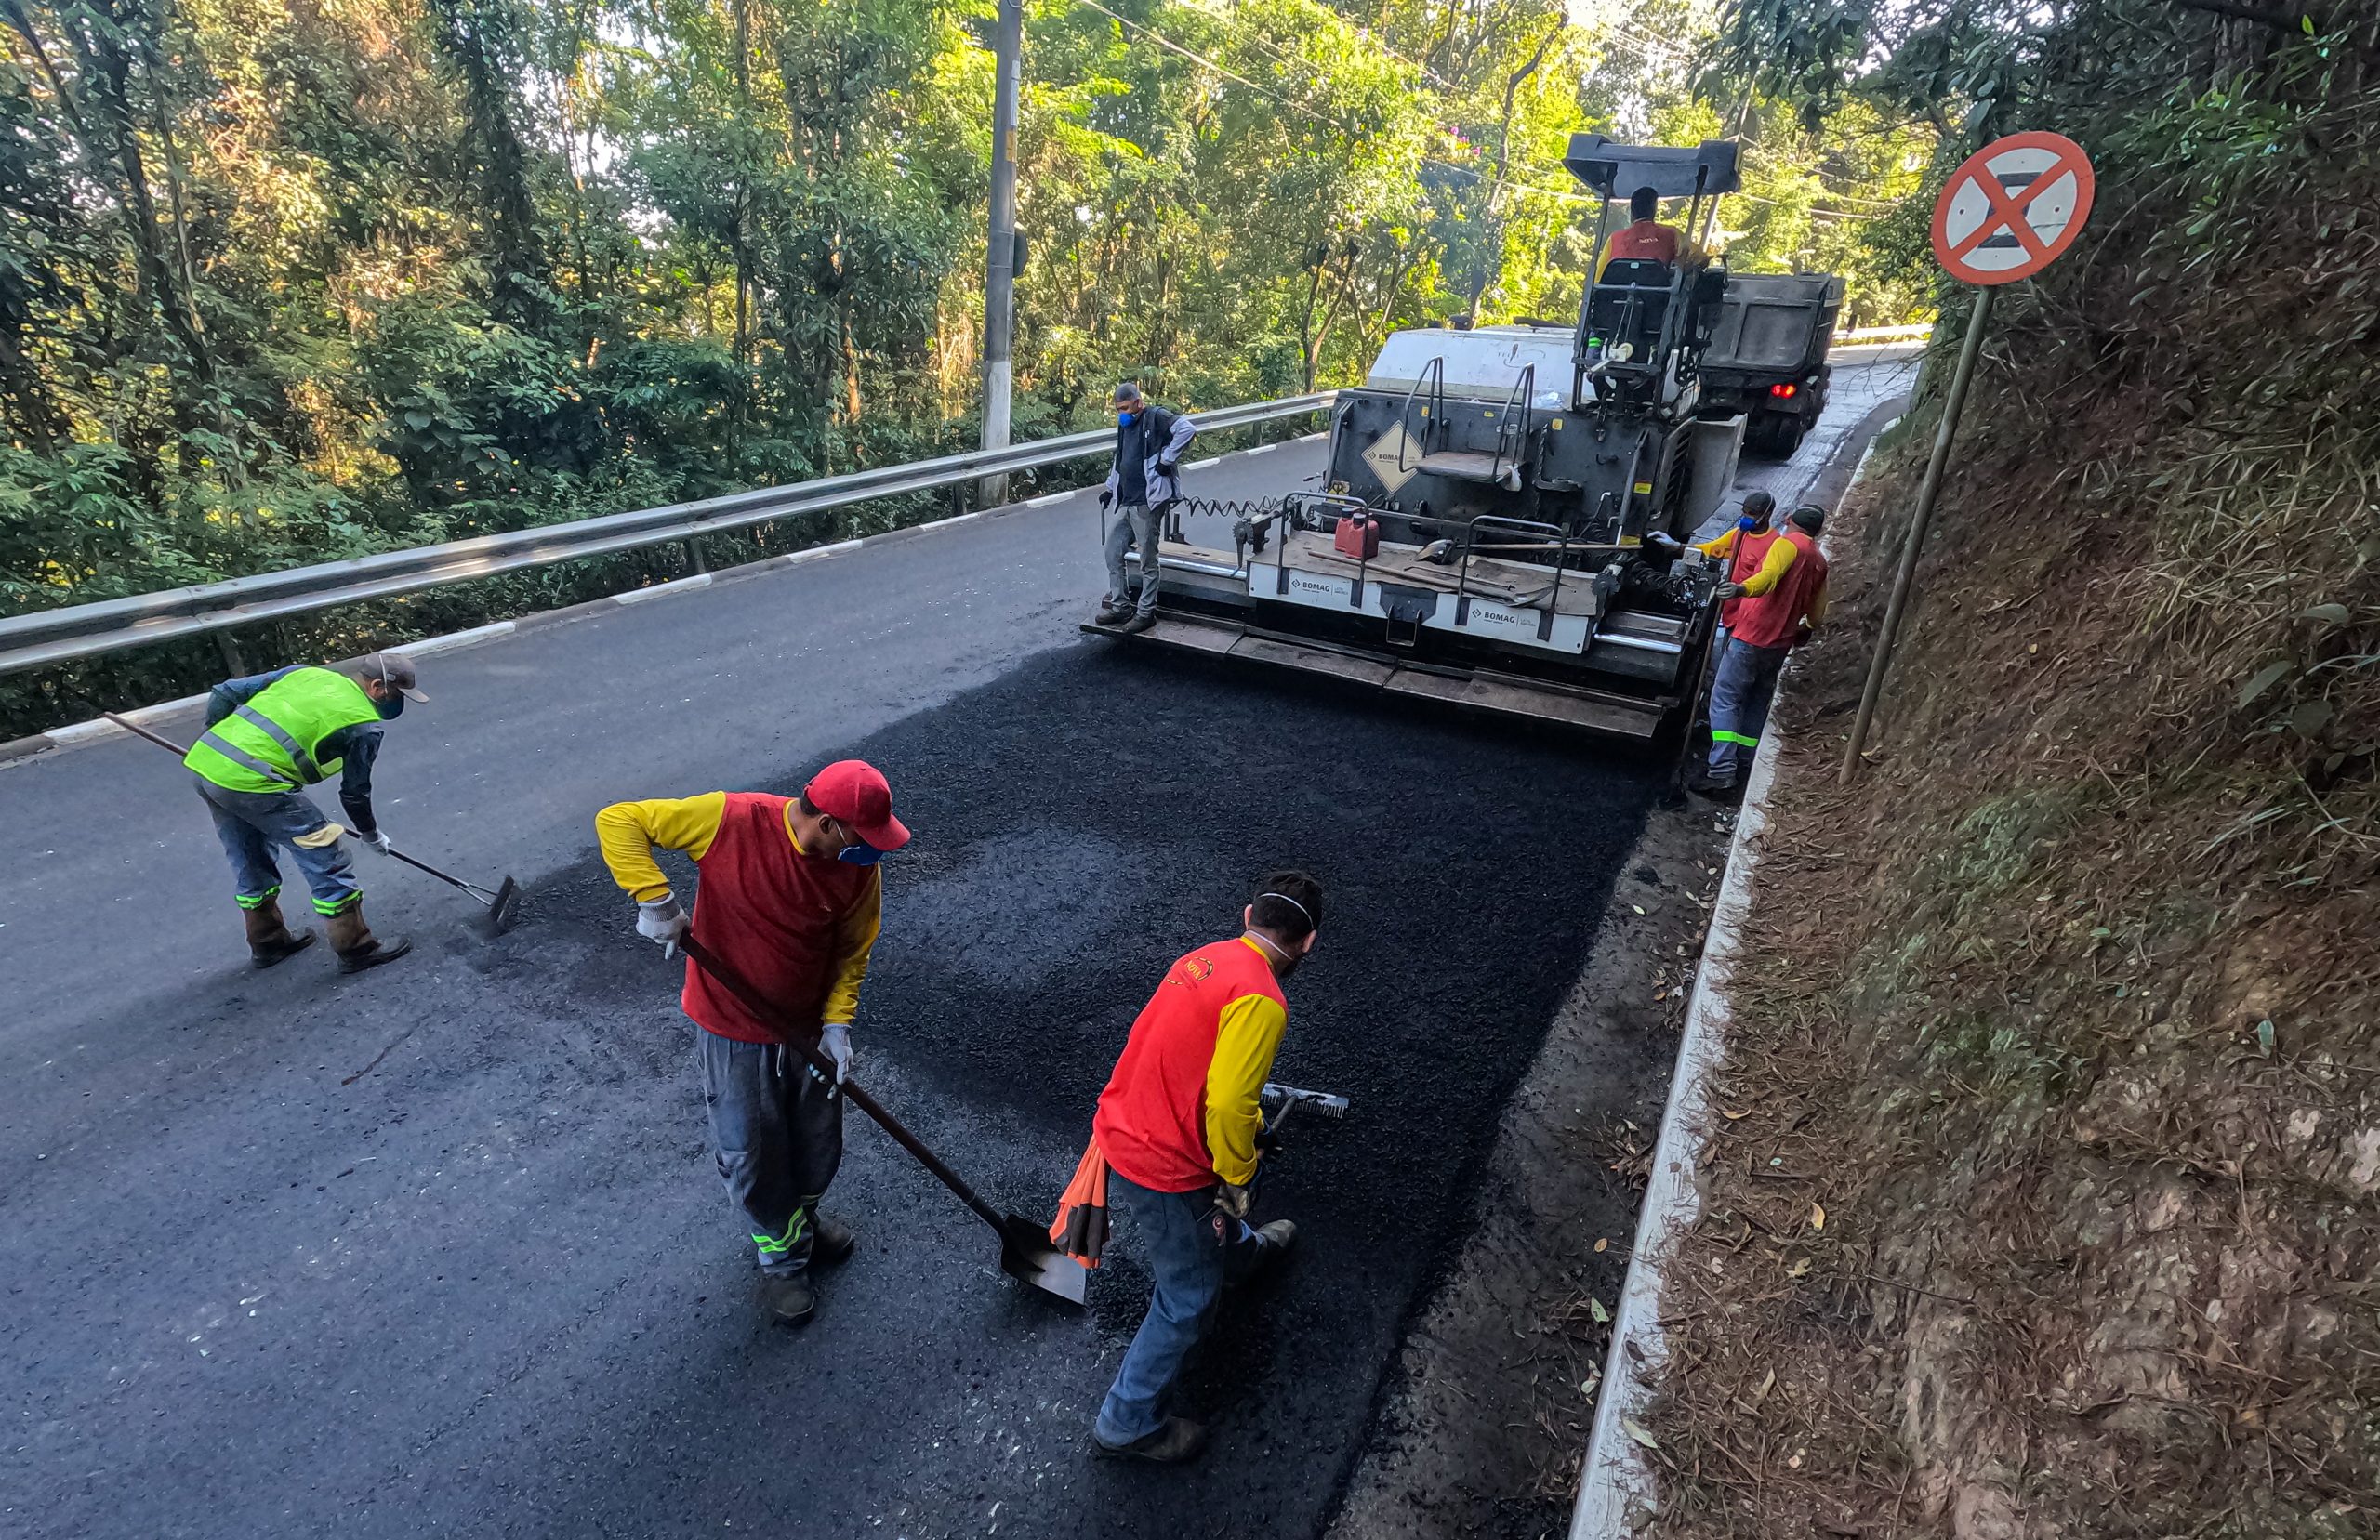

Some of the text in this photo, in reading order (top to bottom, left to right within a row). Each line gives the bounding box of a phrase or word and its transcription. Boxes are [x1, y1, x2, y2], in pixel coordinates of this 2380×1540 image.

[1379, 453, 1401, 462] BOMA
[1302, 582, 1329, 592] BOMAG
[1484, 612, 1514, 623] BOMAG
[1184, 960, 1202, 979] NOVA
